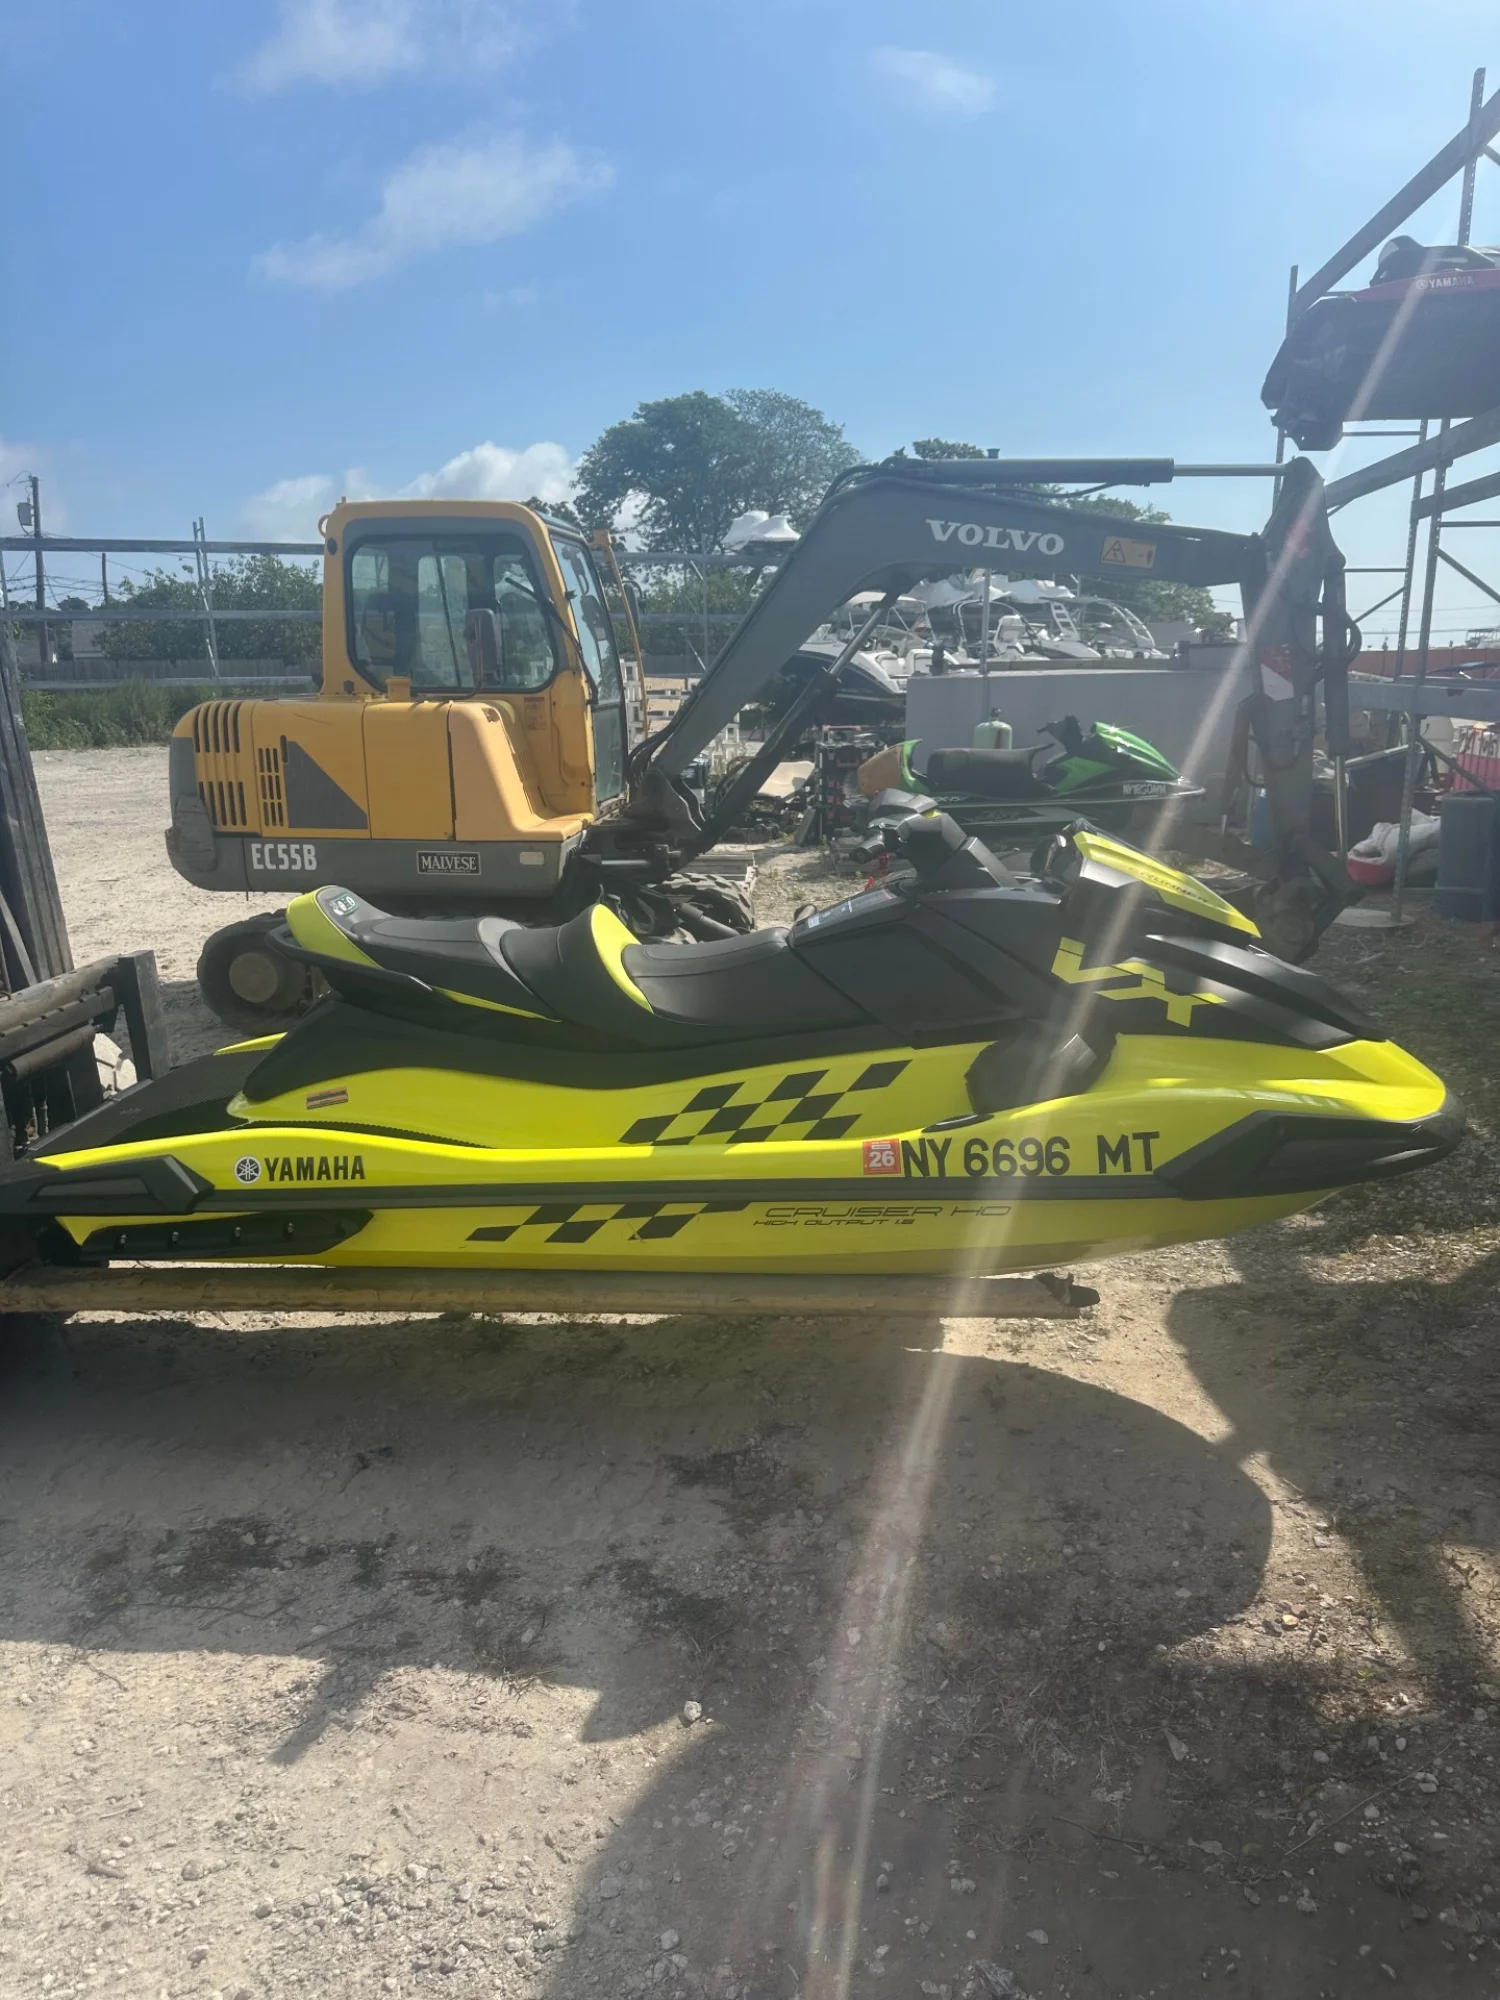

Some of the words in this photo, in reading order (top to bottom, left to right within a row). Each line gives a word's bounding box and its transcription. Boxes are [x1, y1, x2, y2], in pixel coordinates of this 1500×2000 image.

[1429, 276, 1474, 289] YAMAHA
[926, 519, 1065, 556] VOLVO
[251, 843, 317, 871] EC55B
[421, 855, 477, 871] MALVESE
[869, 1150, 896, 1168] 26
[901, 1139, 952, 1177] NY
[963, 1137, 1071, 1177] 6696
[1097, 1131, 1160, 1174] MT
[264, 1155, 365, 1182] YAMAHA
[765, 1207, 943, 1218] CRUISER
[951, 1206, 1012, 1216] HO
